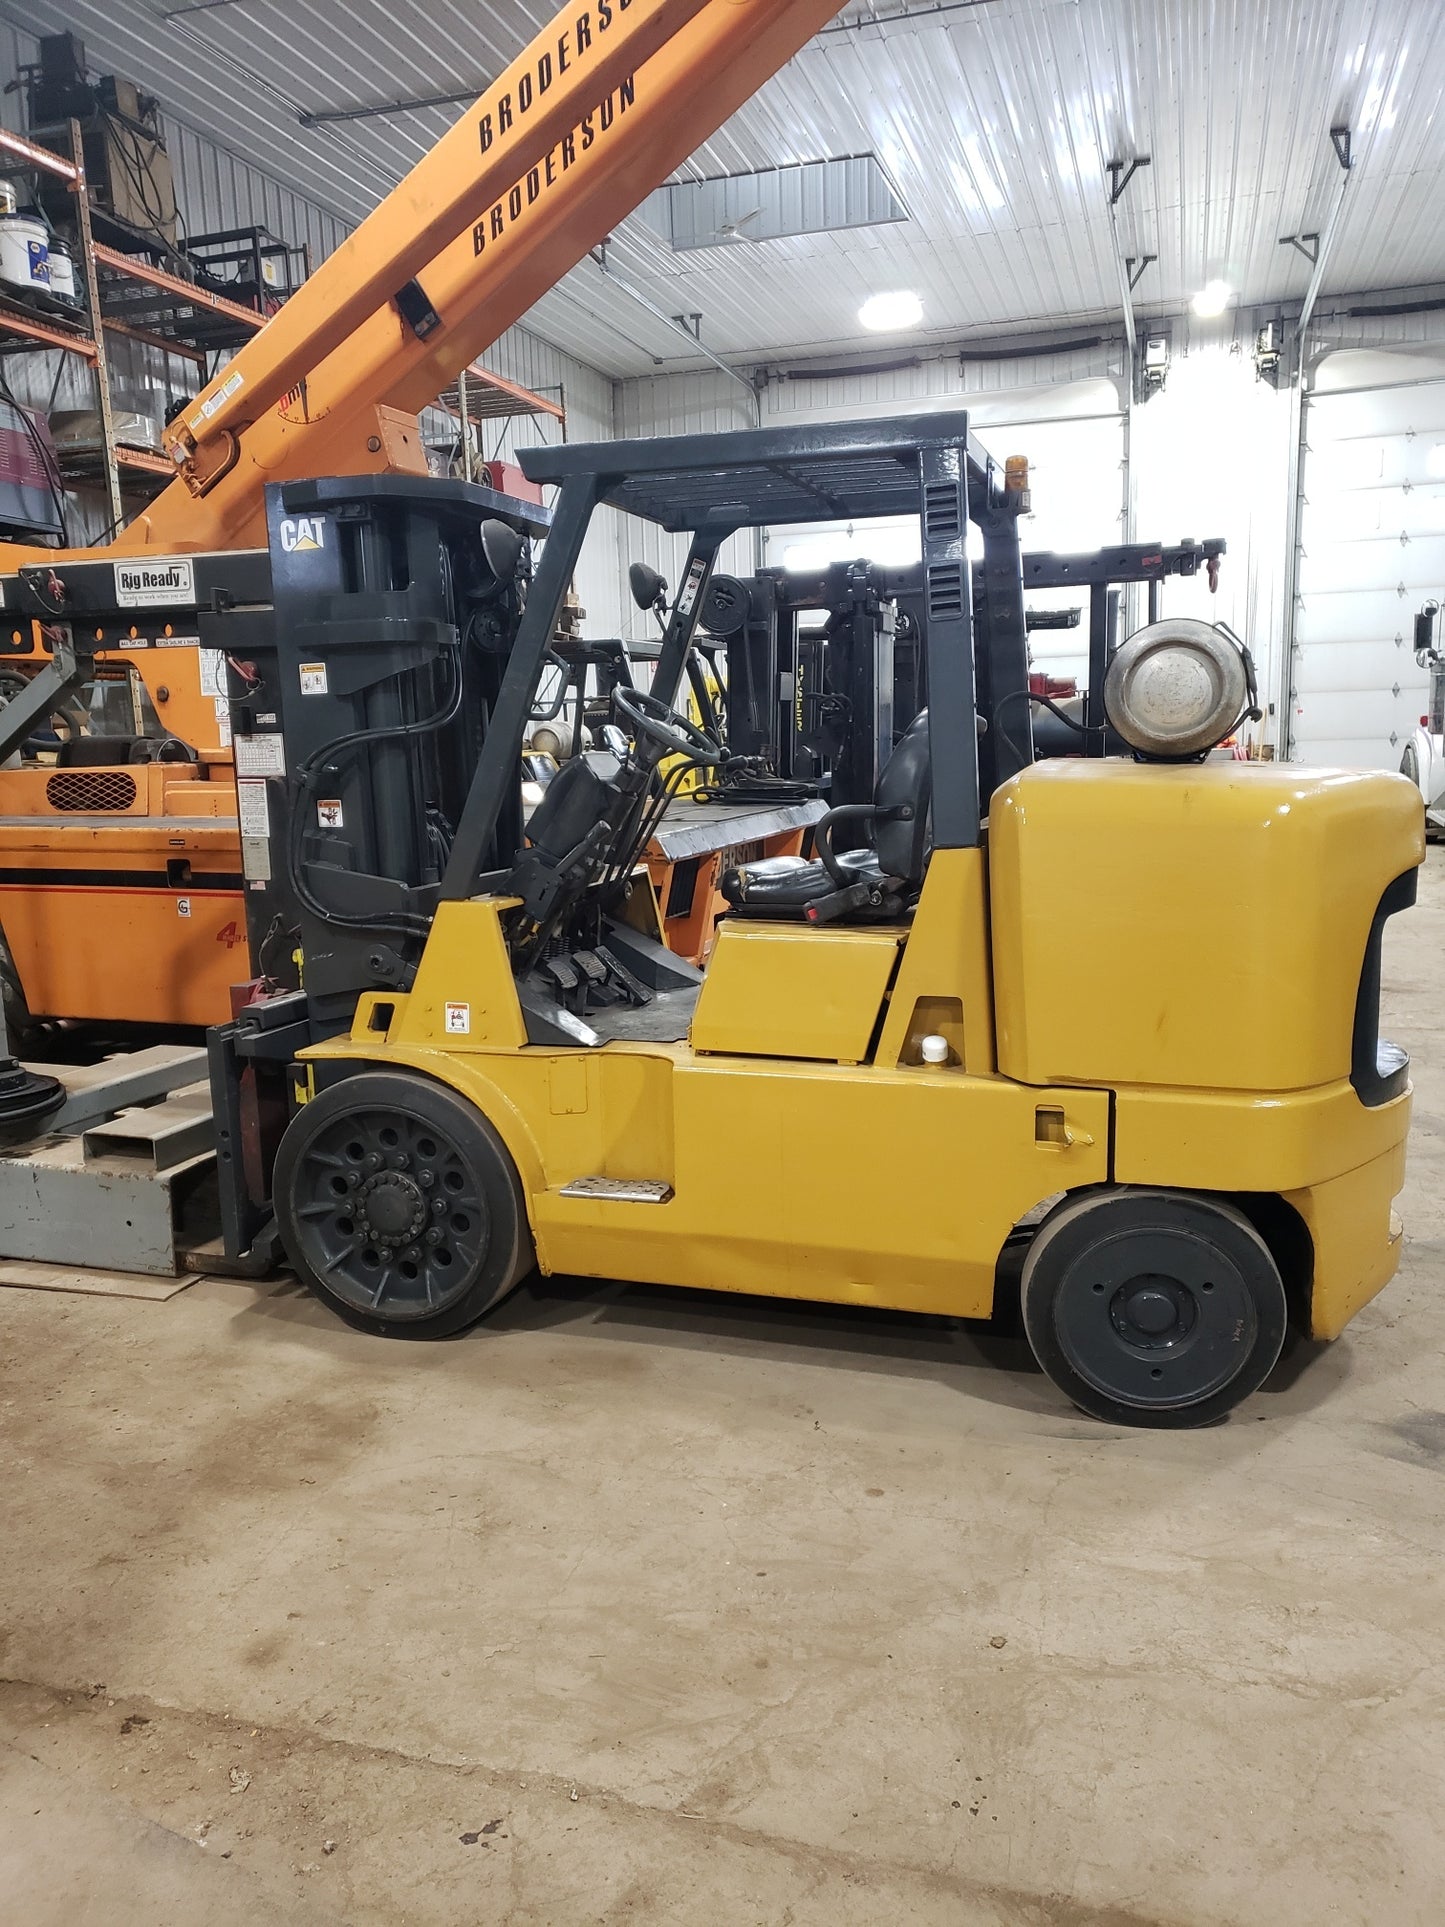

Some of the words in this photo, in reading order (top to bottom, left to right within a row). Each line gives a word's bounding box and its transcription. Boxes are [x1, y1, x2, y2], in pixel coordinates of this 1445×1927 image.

[479, 0, 632, 155] BRODERS
[280, 517, 325, 551] CAT
[121, 573, 140, 590] Rig
[142, 567, 180, 587] Ready
[216, 921, 237, 949] 4
